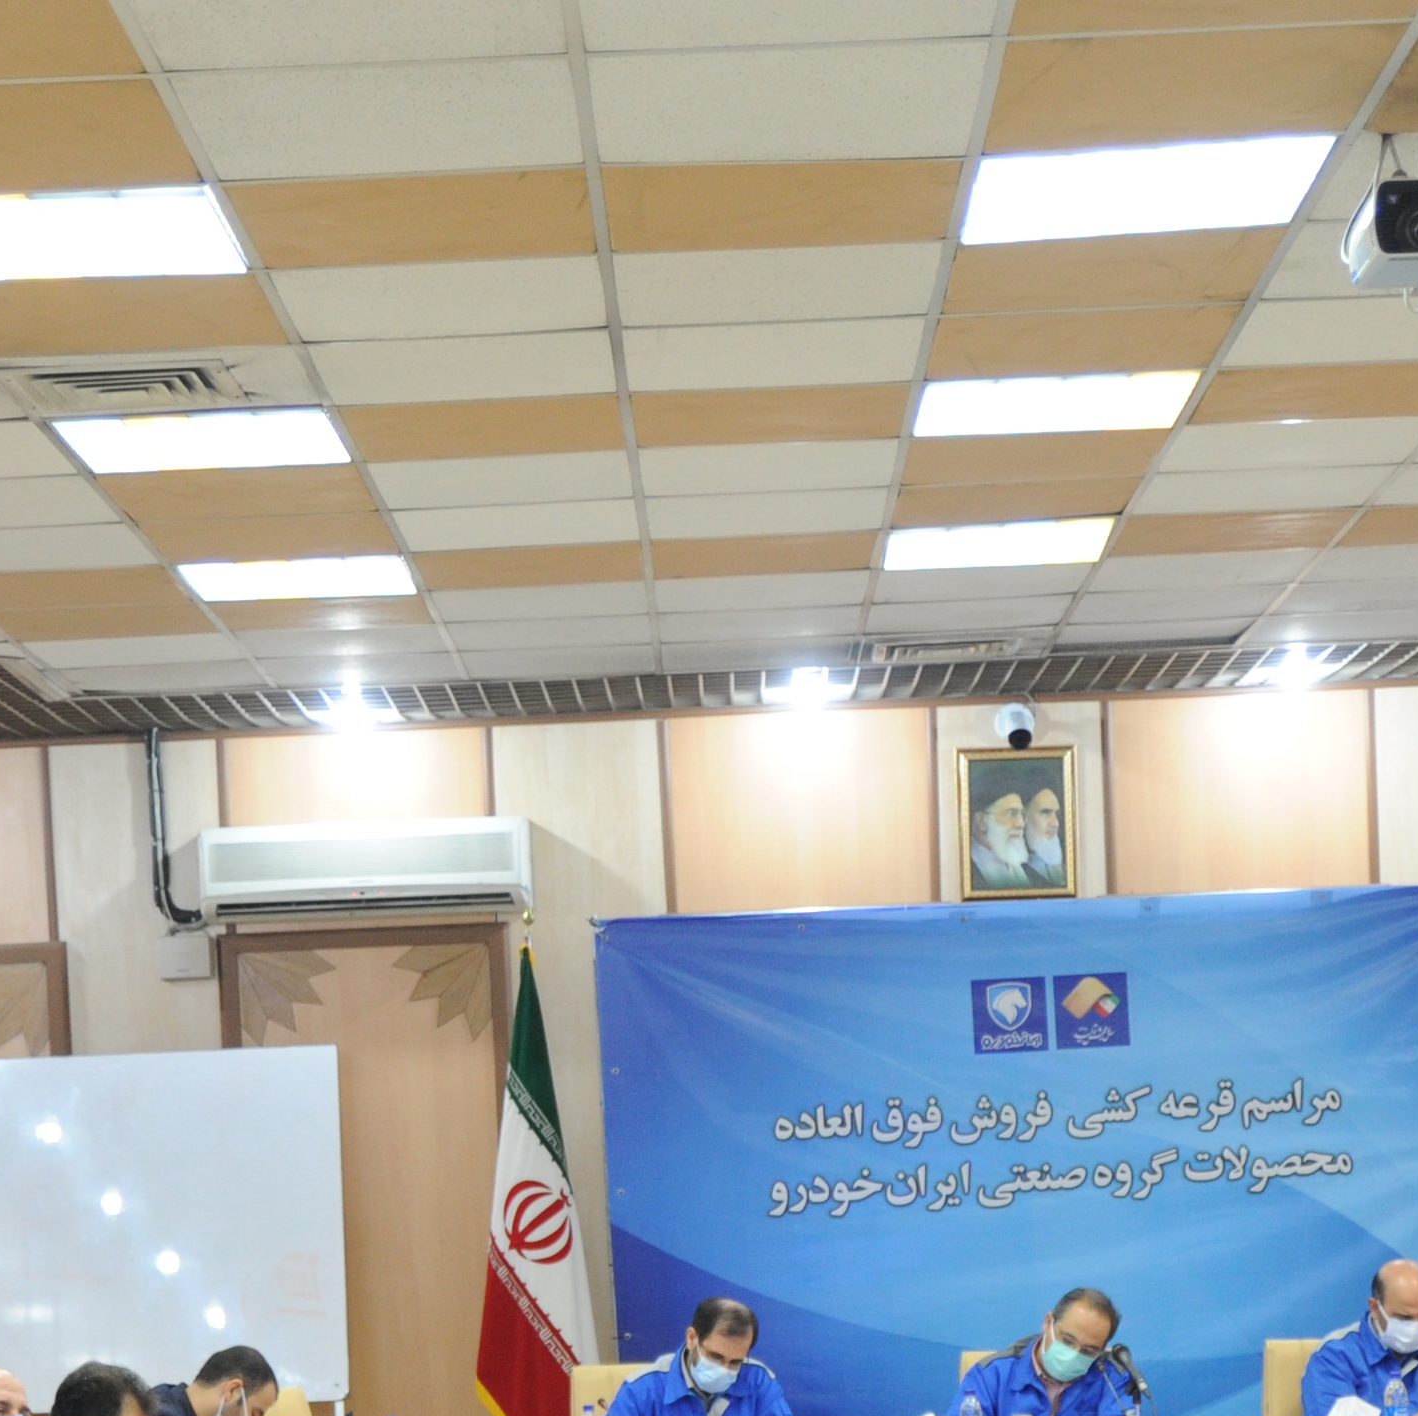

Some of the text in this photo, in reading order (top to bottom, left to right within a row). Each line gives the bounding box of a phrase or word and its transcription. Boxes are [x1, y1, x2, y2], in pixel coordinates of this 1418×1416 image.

[774, 1077, 1341, 1148] مراسم قرعه کشی فروش فوق العاده
[977, 1153, 1087, 1208] صنعتی
[1093, 1147, 1179, 1200] گروه
[1184, 1145, 1353, 1194] محصولات
